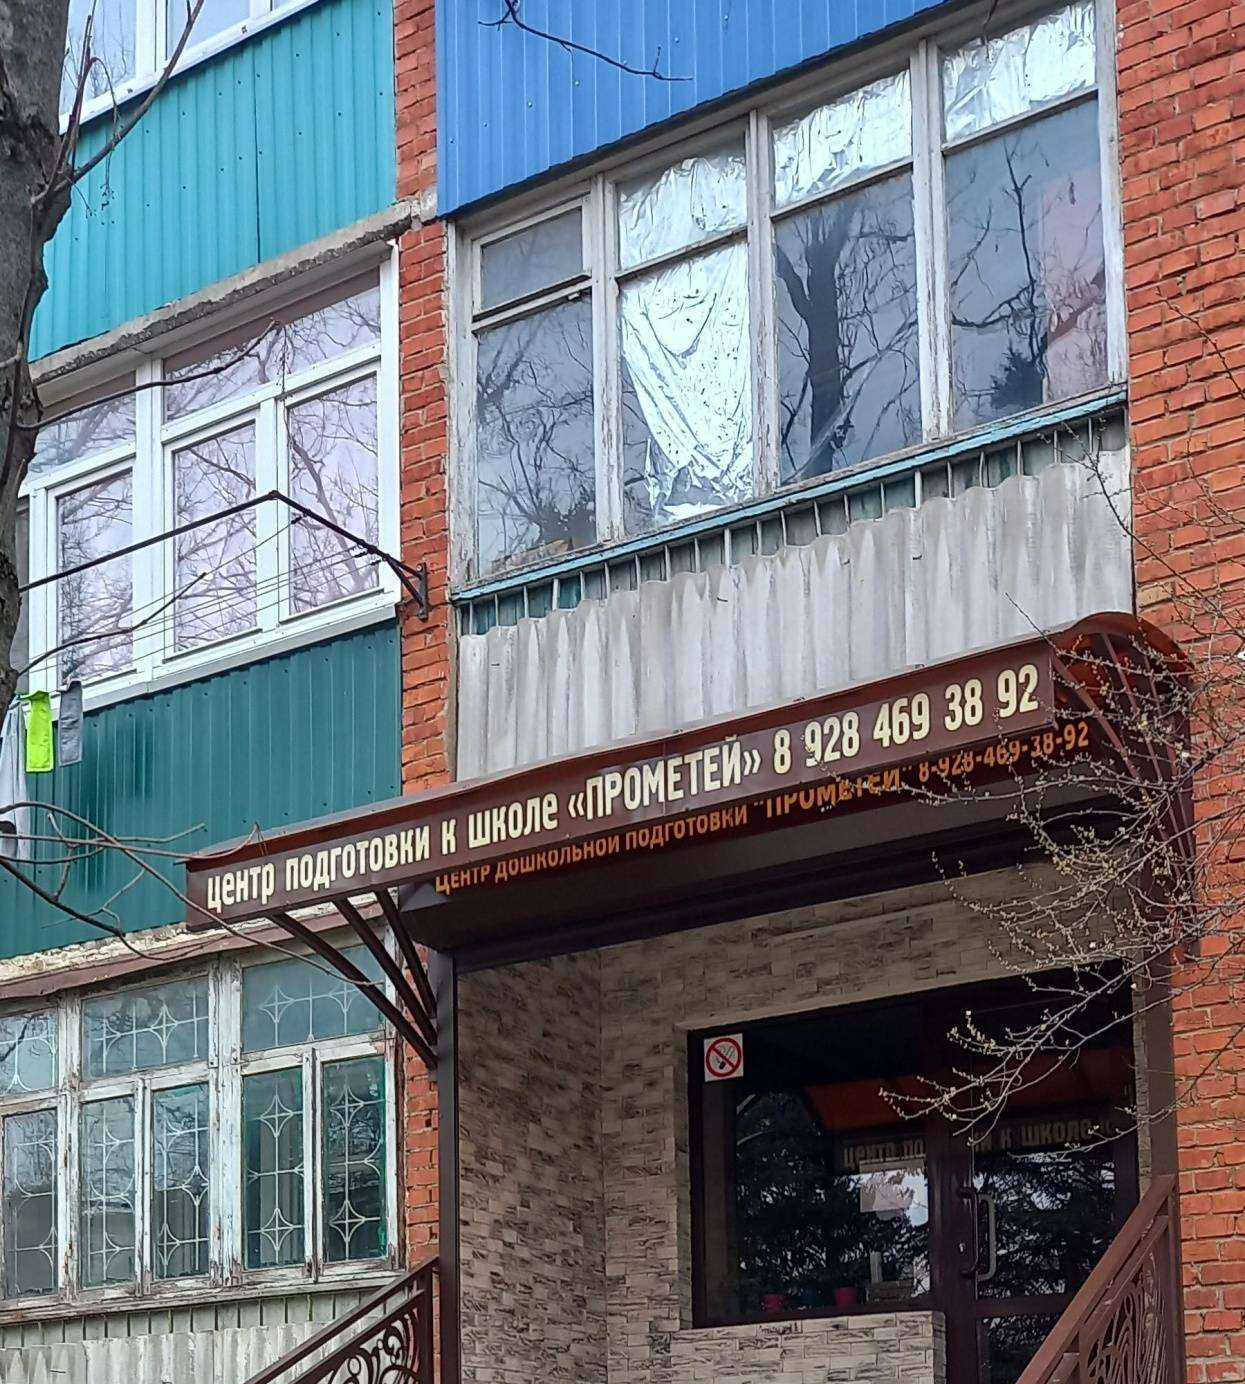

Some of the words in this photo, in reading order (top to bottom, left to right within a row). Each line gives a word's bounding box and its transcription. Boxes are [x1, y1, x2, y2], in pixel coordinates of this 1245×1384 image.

[207, 861, 275, 911] центр
[285, 825, 430, 891] подготовки
[468, 793, 559, 850] школе
[567, 734, 762, 821] «ПРОМЕТЕЙ»
[773, 729, 791, 774] 8
[804, 711, 860, 768] 928
[873, 692, 930, 748] 469
[944, 678, 983, 732] 38
[997, 663, 1039, 719] 92
[435, 864, 491, 896] ЦЕНТР
[625, 804, 748, 850] ПОДГОТОВКИ
